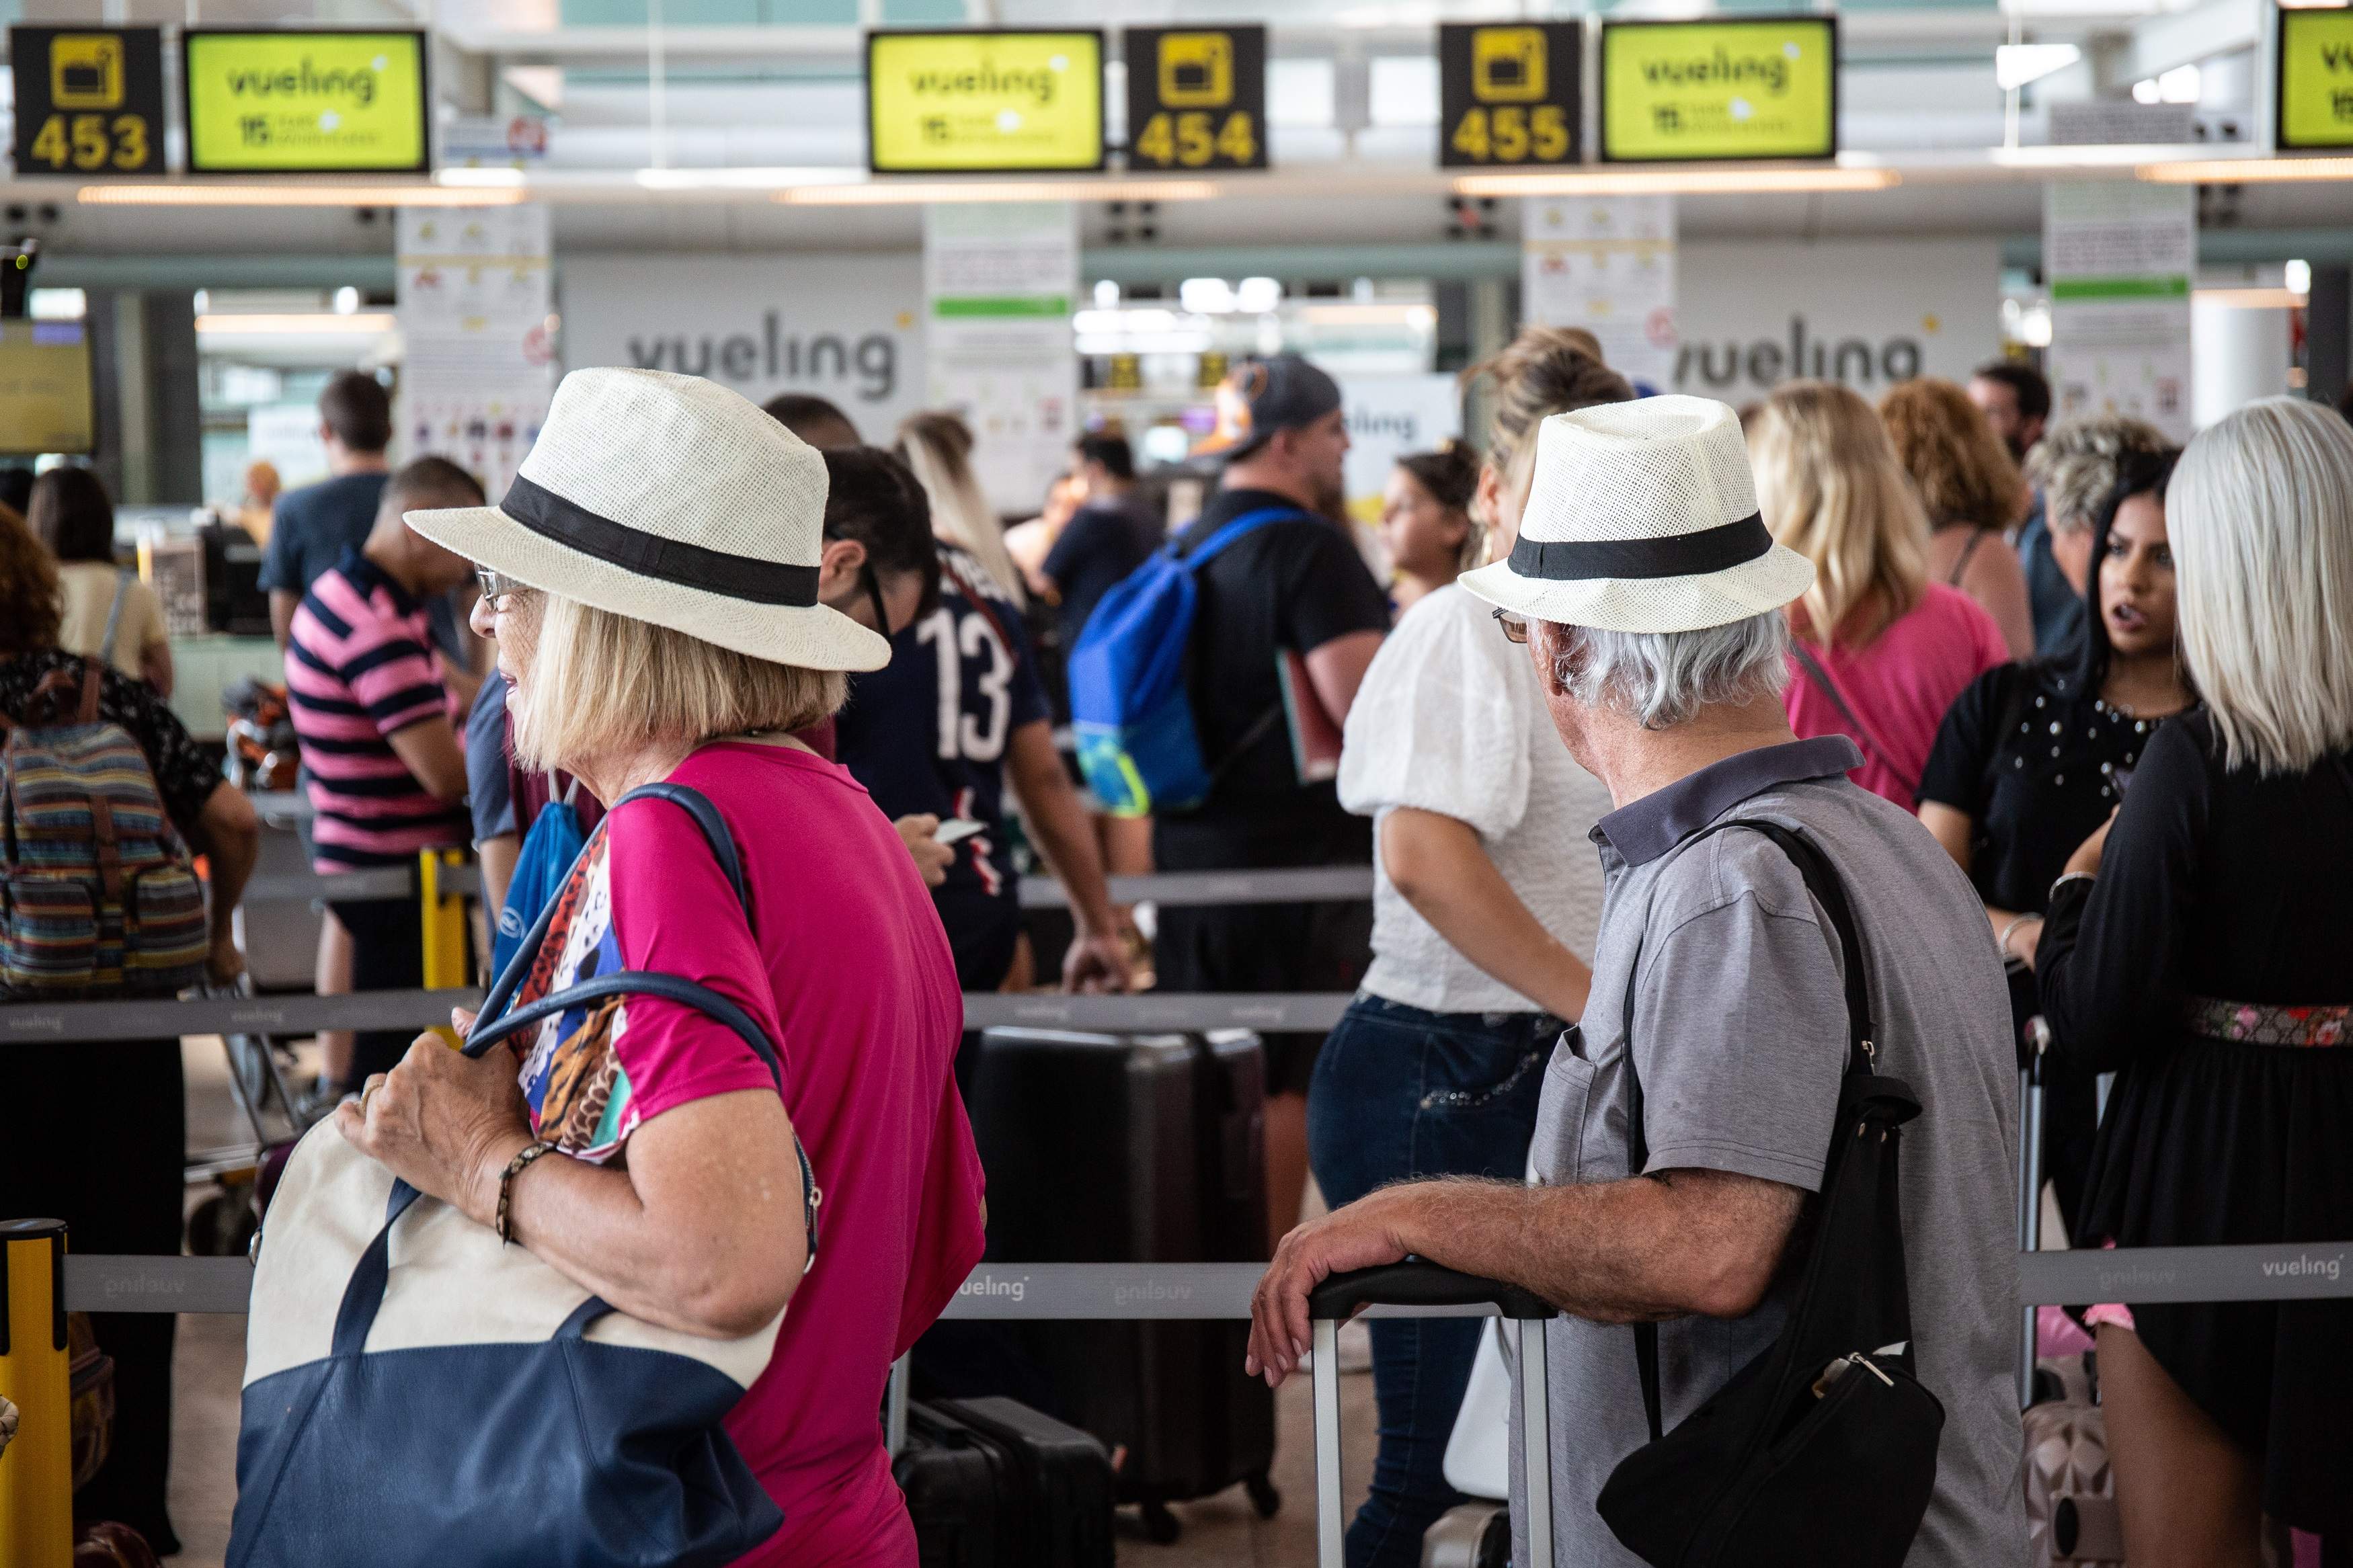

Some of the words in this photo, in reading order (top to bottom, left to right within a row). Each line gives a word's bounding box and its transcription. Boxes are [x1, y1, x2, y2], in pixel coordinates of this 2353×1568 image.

[226, 58, 378, 106] vueling
[910, 59, 1055, 103] vueling
[1640, 50, 1790, 95] vueling
[30, 115, 149, 170] 453
[1136, 112, 1254, 166] 454
[1451, 106, 1569, 161] 455
[628, 310, 898, 402] vueling
[917, 607, 1011, 762] 13
[959, 1276, 1025, 1302] ueling
[2261, 1253, 2340, 1280] vueling
